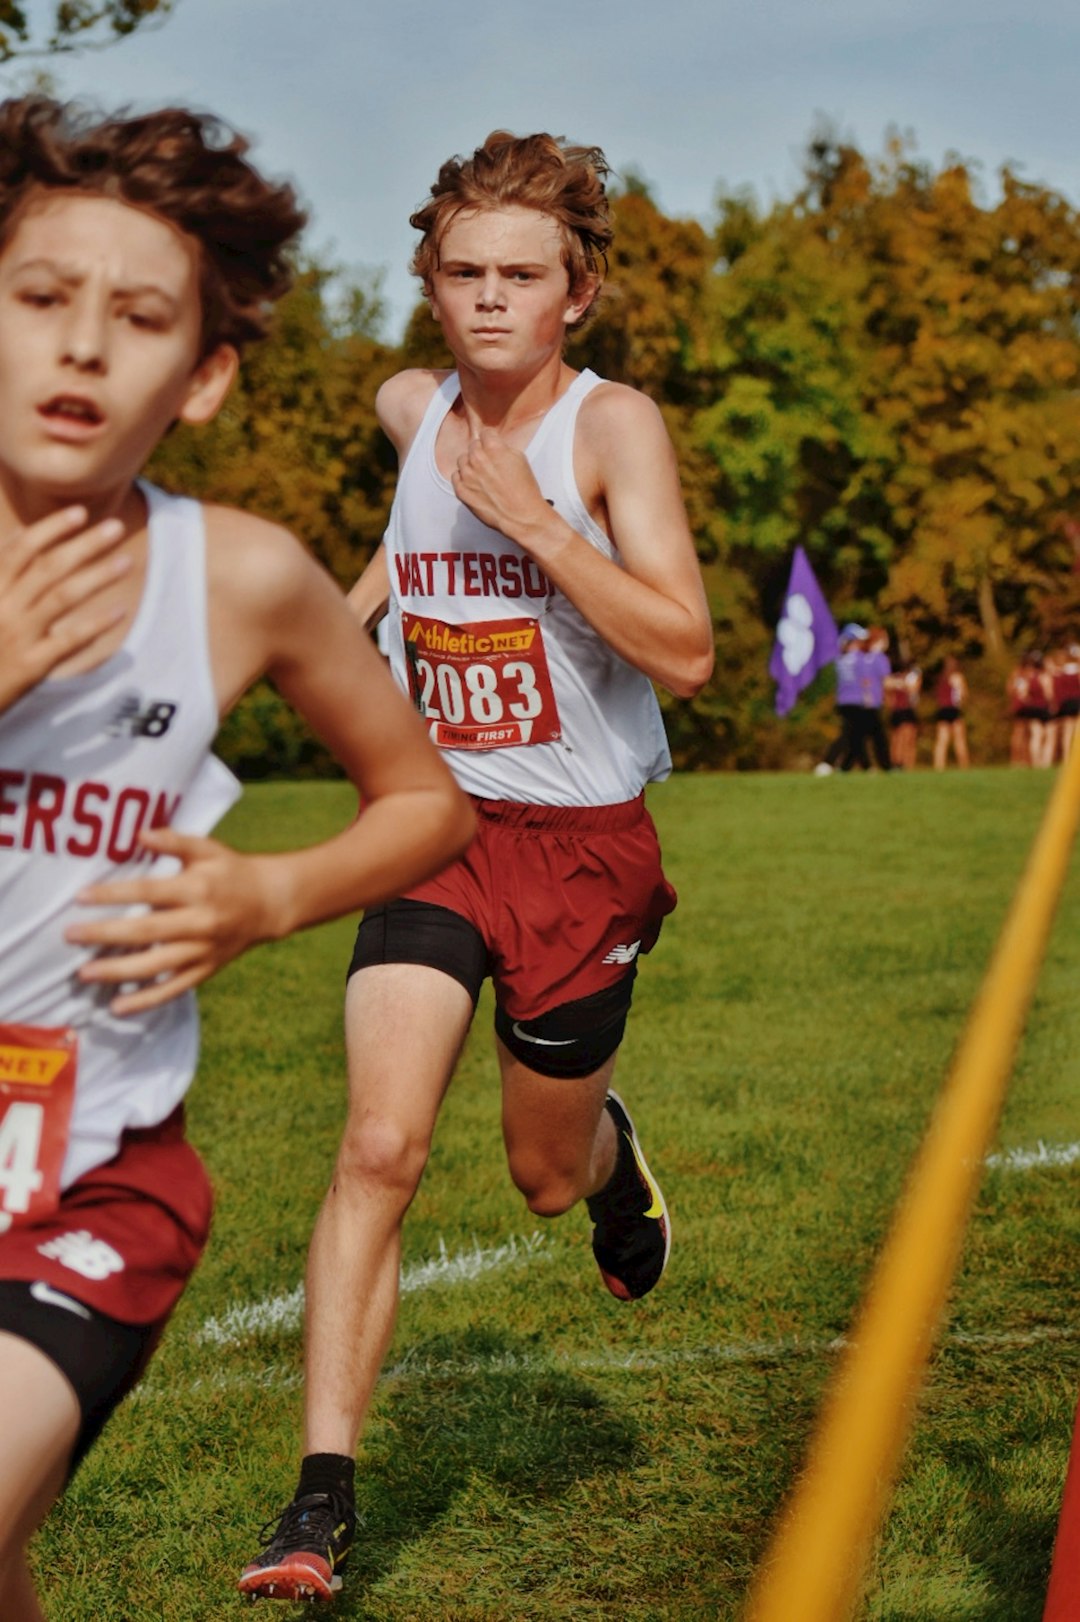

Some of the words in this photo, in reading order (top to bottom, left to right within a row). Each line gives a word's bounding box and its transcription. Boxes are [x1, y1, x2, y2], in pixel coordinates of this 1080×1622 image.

[395, 552, 556, 598] WATTERSO
[408, 621, 491, 654] Athletic
[497, 635, 529, 649] NET
[416, 659, 543, 724] 2083
[0, 1101, 44, 1214] 4
